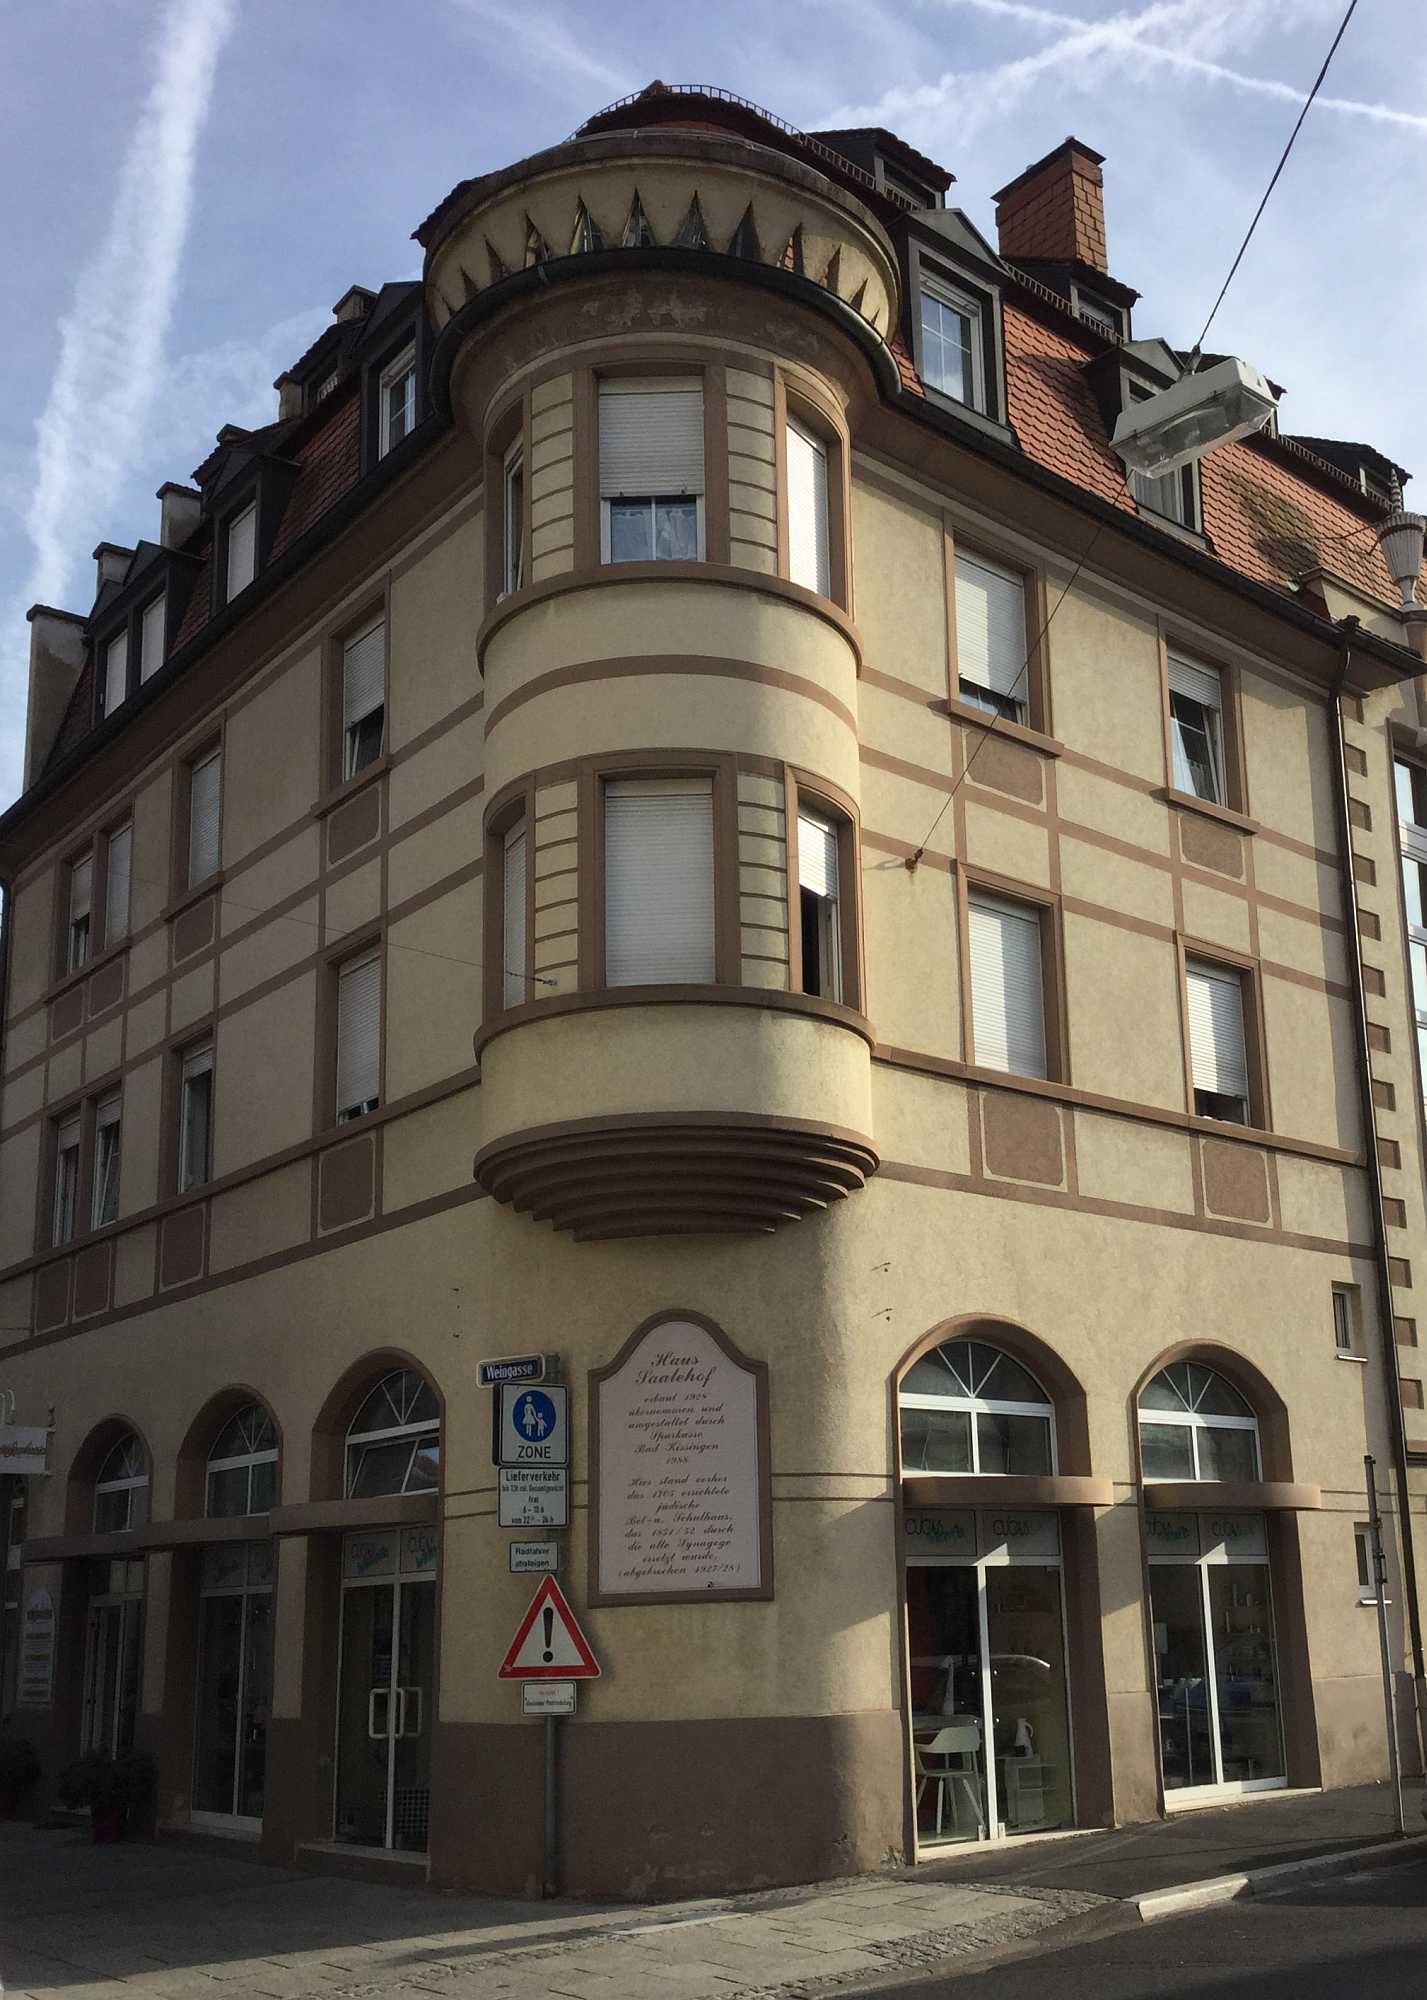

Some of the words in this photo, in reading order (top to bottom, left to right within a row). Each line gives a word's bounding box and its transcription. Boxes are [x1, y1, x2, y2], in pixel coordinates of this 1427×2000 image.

[650, 1351, 700, 1367] Haus
[486, 1363, 533, 1382] Weingasse
[635, 1367, 717, 1388] Saalehof
[701, 1403, 725, 1413] und
[694, 1415, 726, 1425] durch
[649, 1430, 704, 1442] Sparkasse
[516, 1445, 552, 1459] ZONE
[634, 1443, 660, 1454] Bad
[664, 1441, 720, 1455] Kissingen
[505, 1470, 561, 1482] Lieferverkehr
[657, 1474, 690, 1486] stand
[626, 1489, 645, 1500] das
[655, 1500, 702, 1513] jüdische
[625, 1528, 642, 1538] das
[703, 1523, 735, 1535] durch
[627, 1541, 643, 1551] die
[649, 1540, 670, 1550] alte
[677, 1538, 732, 1551] Synagoge
[515, 1547, 550, 1556] Radfahrer
